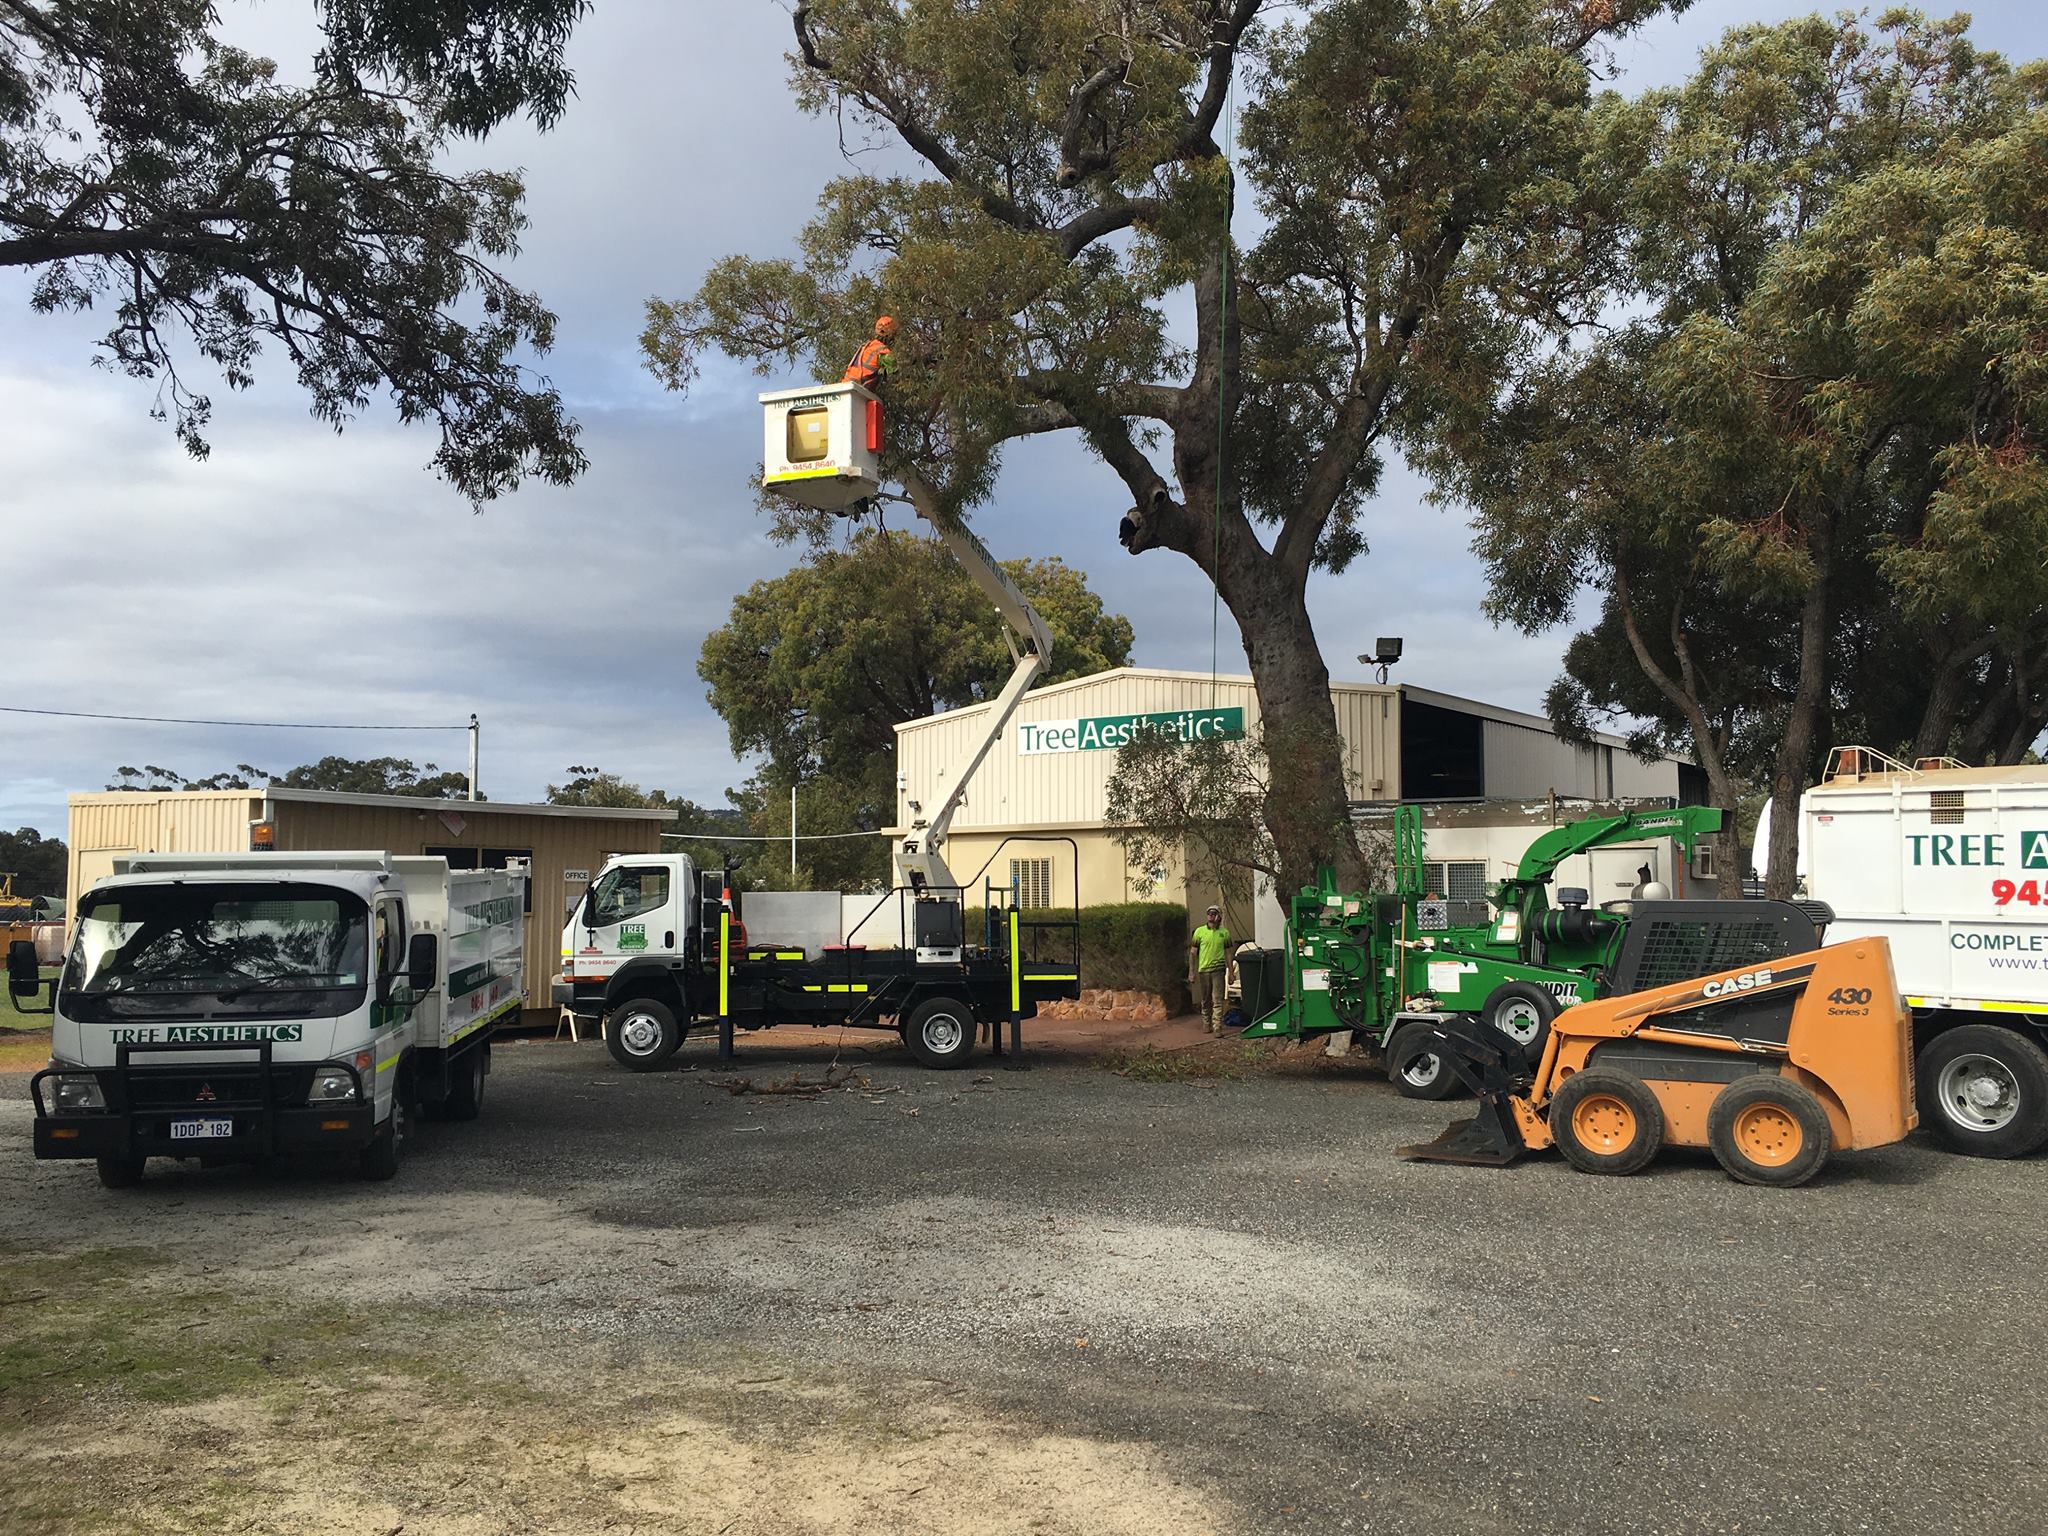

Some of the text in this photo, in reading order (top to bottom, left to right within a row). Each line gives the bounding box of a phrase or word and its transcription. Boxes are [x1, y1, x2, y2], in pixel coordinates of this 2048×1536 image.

[1905, 834, 2005, 866] TREE
[565, 871, 588, 879] OFFICE
[1992, 879, 2048, 905] 94
[621, 925, 644, 933] TREE
[1951, 933, 2048, 951] COMPLE
[1703, 969, 1771, 997] CASE
[1827, 988, 1872, 1004] 430
[1828, 1007, 1860, 1015] Series
[109, 1025, 300, 1044] TREE AESTHETICS
